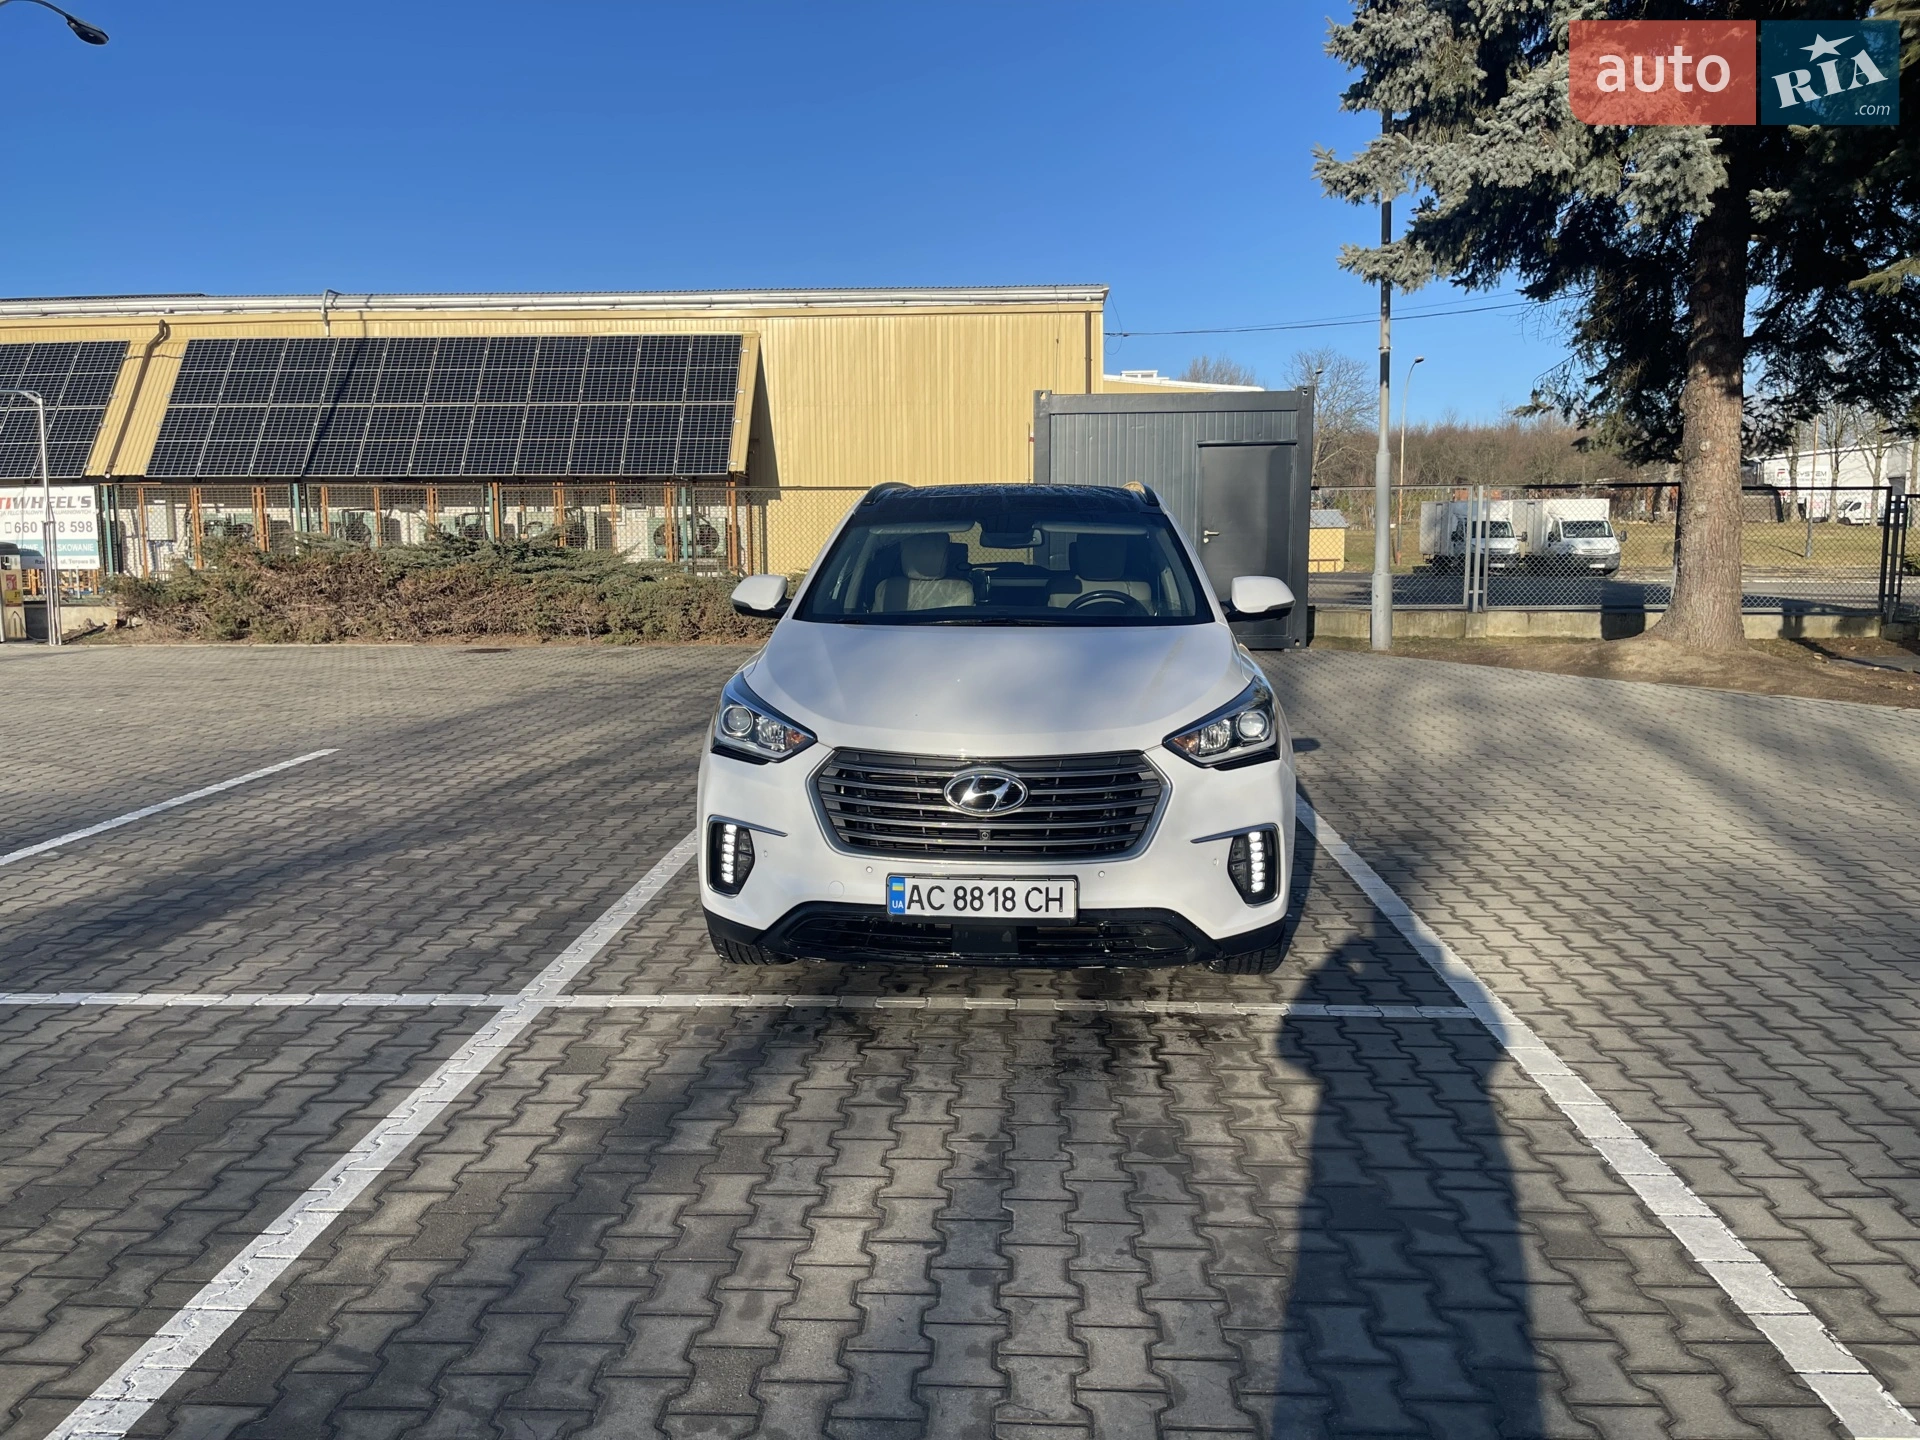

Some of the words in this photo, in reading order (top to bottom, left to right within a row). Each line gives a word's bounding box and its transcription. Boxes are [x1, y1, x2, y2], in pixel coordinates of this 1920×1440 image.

[14, 521, 38, 533] 660
[70, 521, 93, 533] 598
[57, 543, 95, 552] SKOWANIE
[906, 884, 945, 911] AC
[953, 885, 1017, 912] 8818
[1024, 886, 1064, 913] CH
[891, 901, 904, 909] UA
